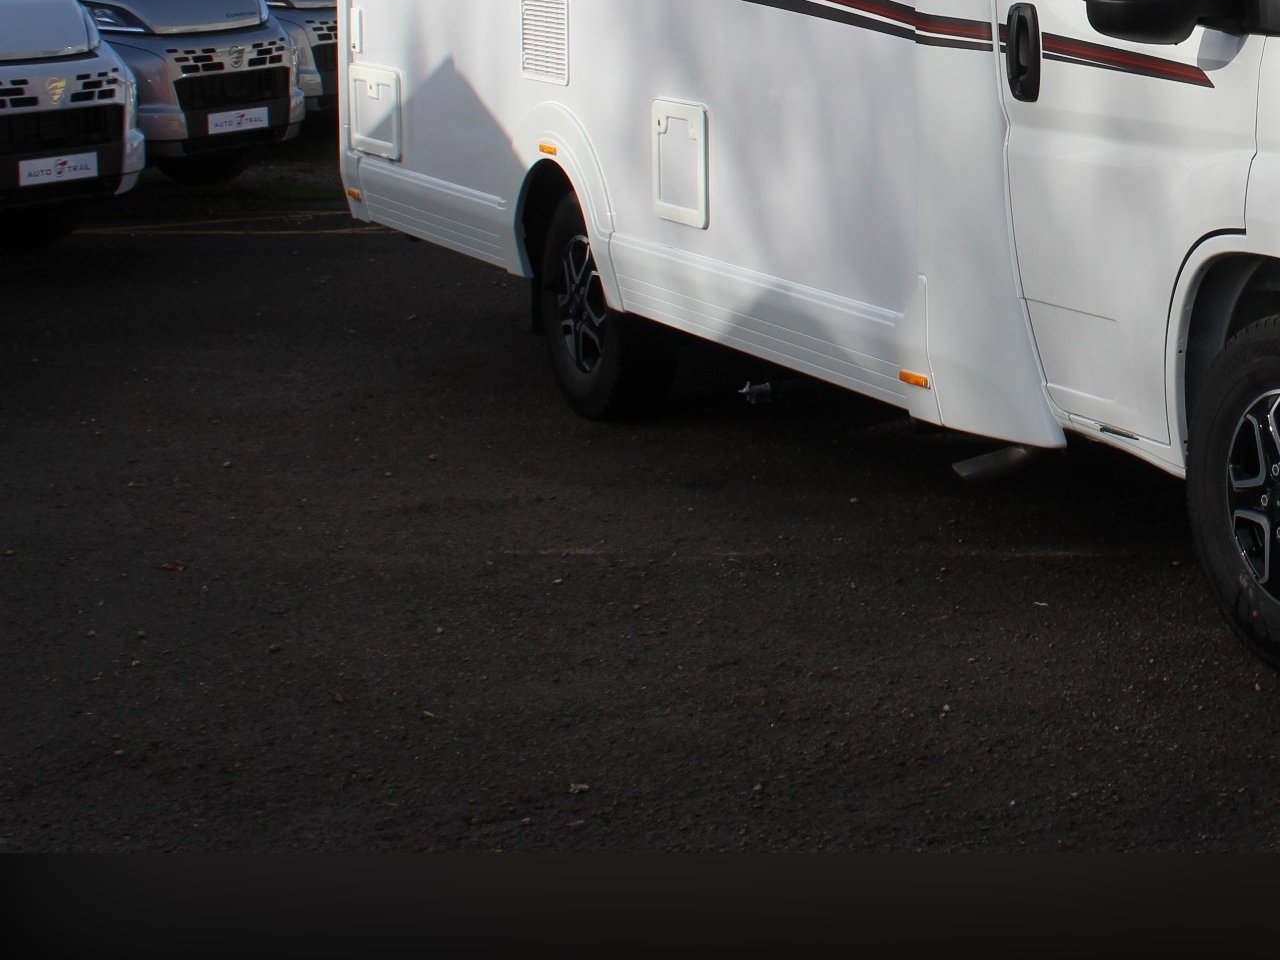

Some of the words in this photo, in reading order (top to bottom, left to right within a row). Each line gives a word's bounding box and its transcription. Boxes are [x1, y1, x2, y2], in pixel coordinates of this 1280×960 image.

[214, 119, 233, 128] AUTO
[245, 116, 263, 124] TRAIL
[27, 168, 52, 178] AUTO
[67, 164, 91, 173] TRAIL
